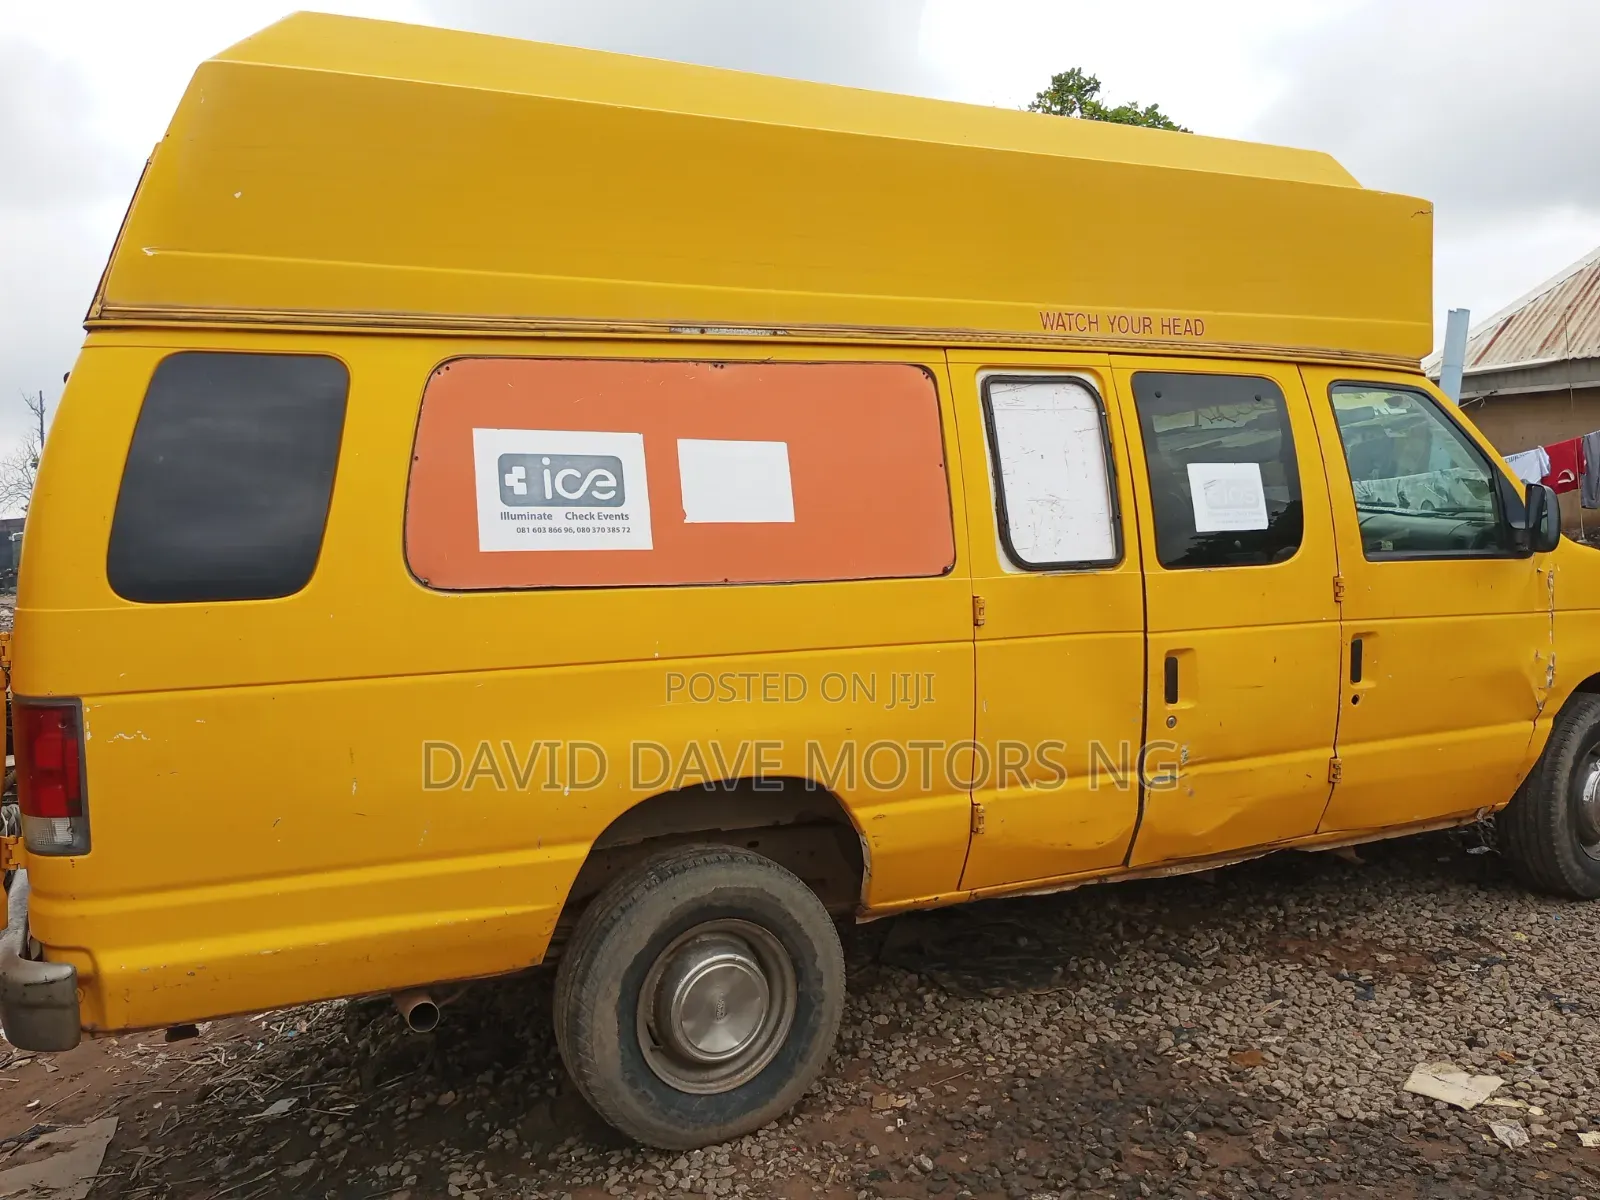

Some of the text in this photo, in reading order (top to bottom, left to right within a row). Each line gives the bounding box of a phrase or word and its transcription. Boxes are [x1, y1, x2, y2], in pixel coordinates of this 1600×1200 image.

[1039, 311, 1205, 337] WATCH YOUR HEAD
[500, 511, 630, 521] Illuminate Check Events
[516, 526, 631, 535] 081 603 866 96, 080 370 385 72
